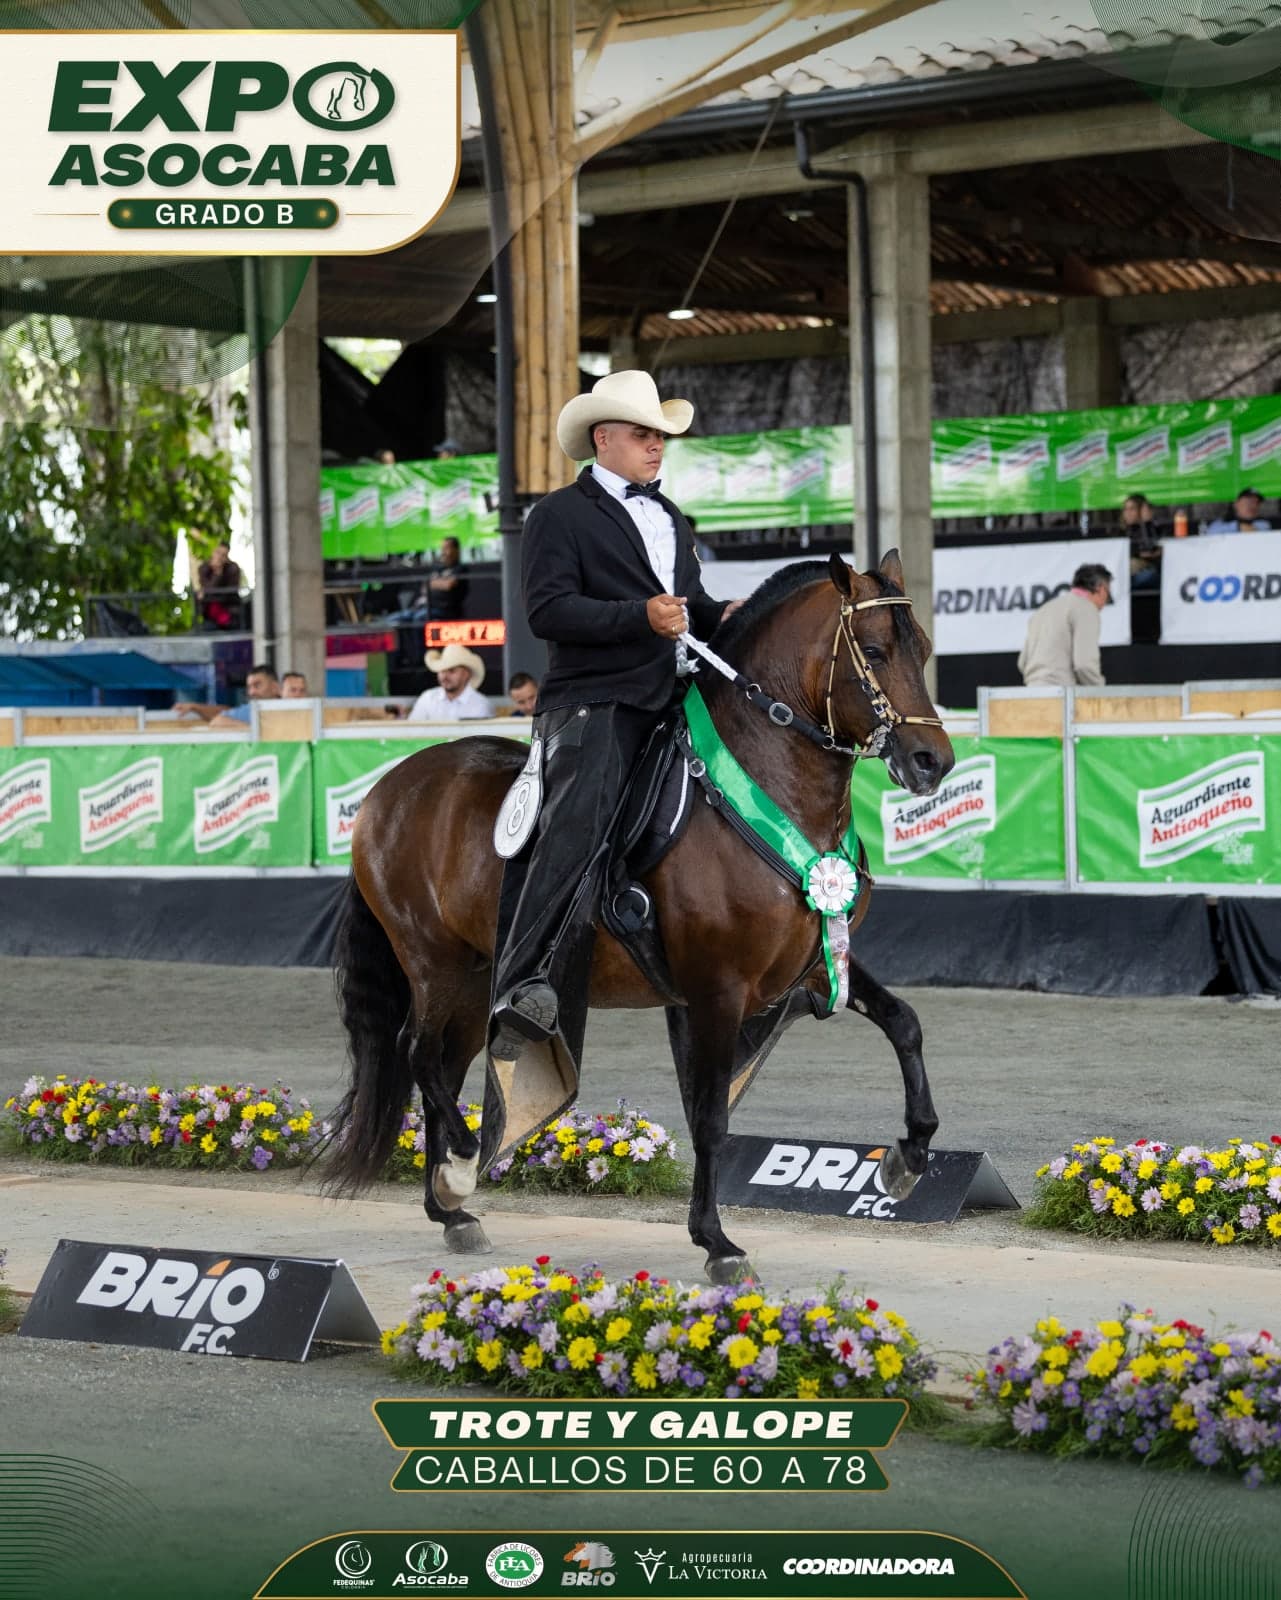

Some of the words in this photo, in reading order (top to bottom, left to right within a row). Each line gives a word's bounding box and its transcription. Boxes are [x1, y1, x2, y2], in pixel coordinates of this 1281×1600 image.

[893, 779, 983, 824] Aguardiente
[894, 794, 984, 842] Antioqueño
[1151, 776, 1251, 825] Aguardiente
[1152, 793, 1253, 844] Antioqueño
[846, 1194, 897, 1218] F.C.
[180, 1322, 236, 1355] F.C.
